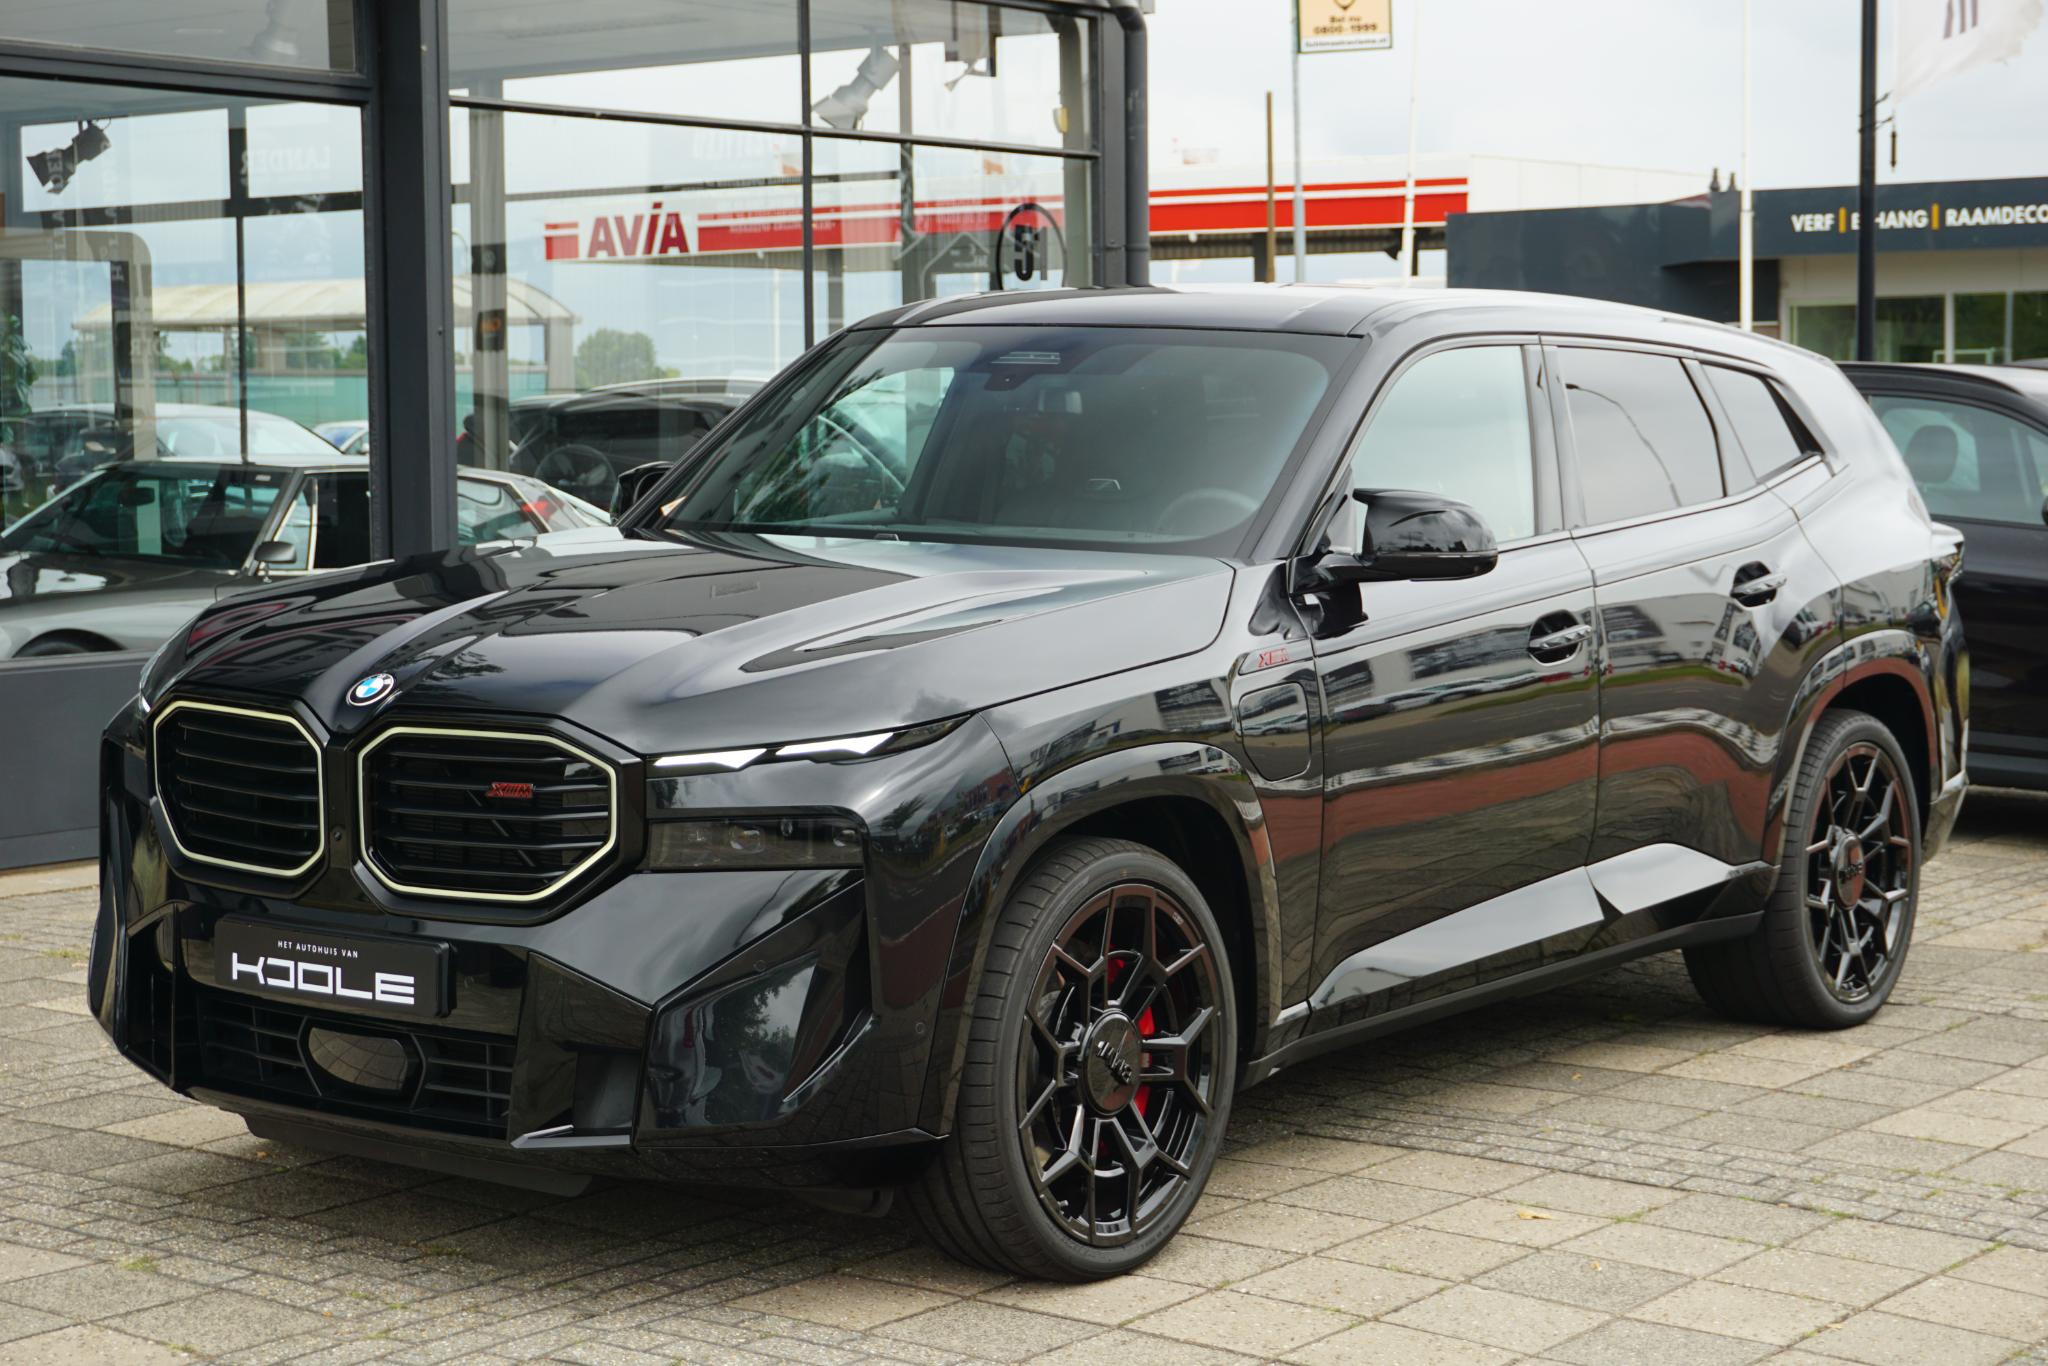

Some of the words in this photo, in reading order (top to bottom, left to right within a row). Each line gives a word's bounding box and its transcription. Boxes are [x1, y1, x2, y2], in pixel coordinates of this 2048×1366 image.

[587, 201, 689, 257] AVIA
[1791, 213, 1835, 232] VERF
[277, 940, 292, 949] HET
[296, 942, 338, 956] AUTOHUIS
[341, 949, 358, 958] VAN
[232, 952, 415, 1005] KOOLE
